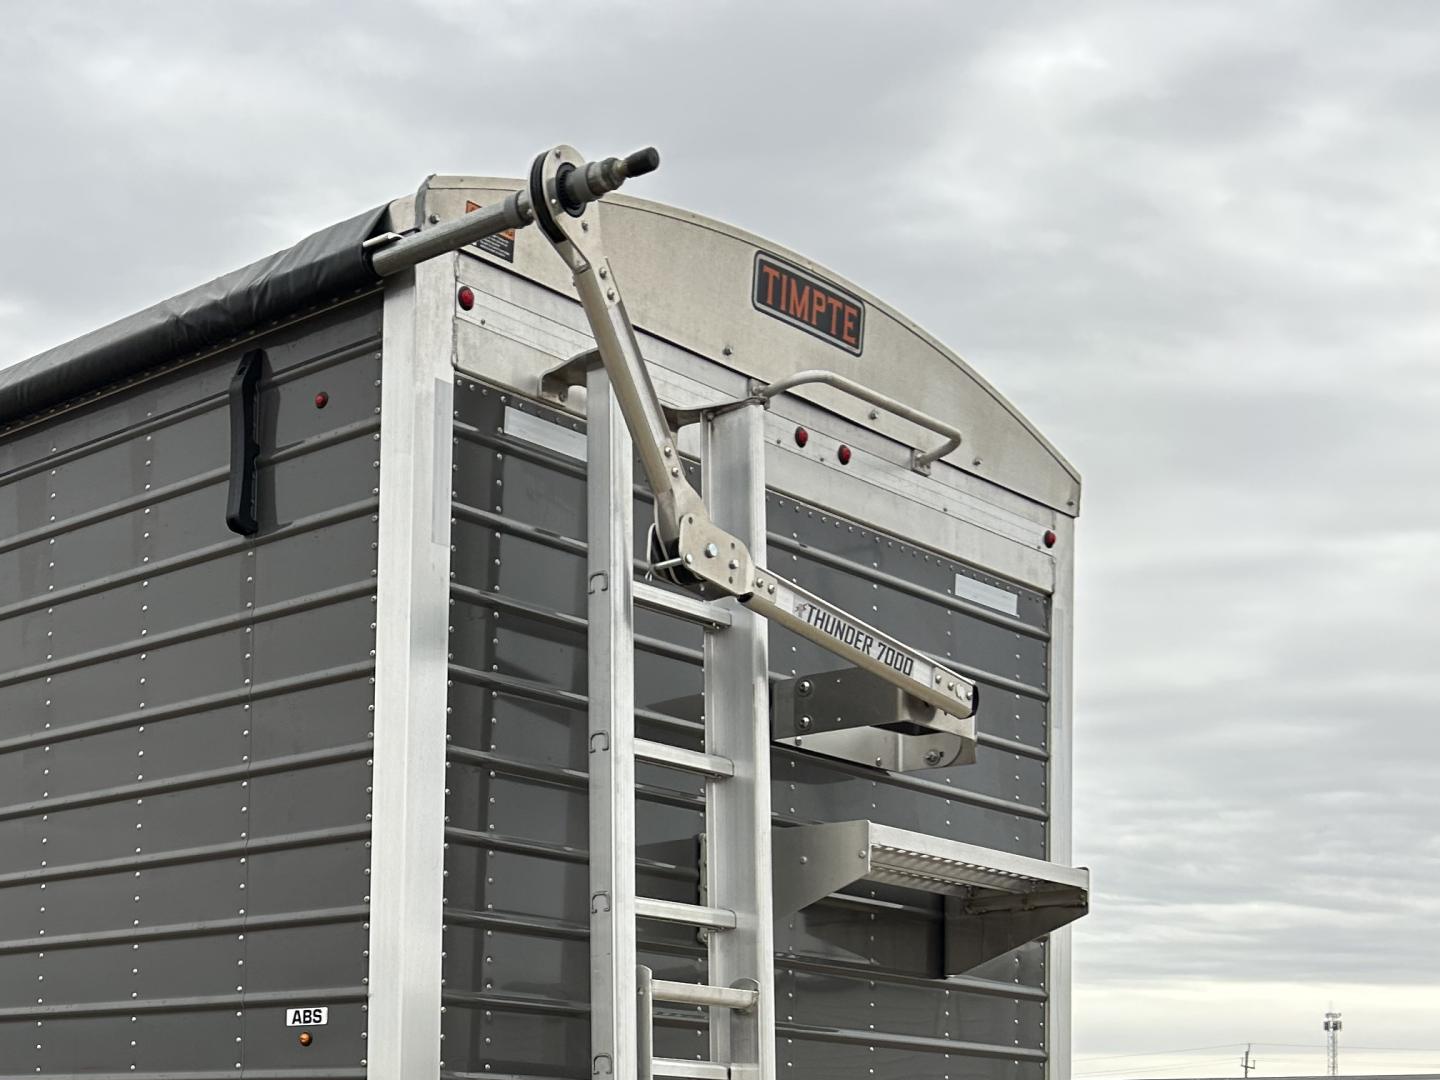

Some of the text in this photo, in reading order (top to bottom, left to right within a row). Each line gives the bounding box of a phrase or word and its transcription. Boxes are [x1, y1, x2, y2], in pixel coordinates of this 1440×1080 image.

[762, 265, 859, 345] TIMPTE
[806, 603, 915, 677] THUNDER 7000
[291, 1008, 323, 1025] ABS
